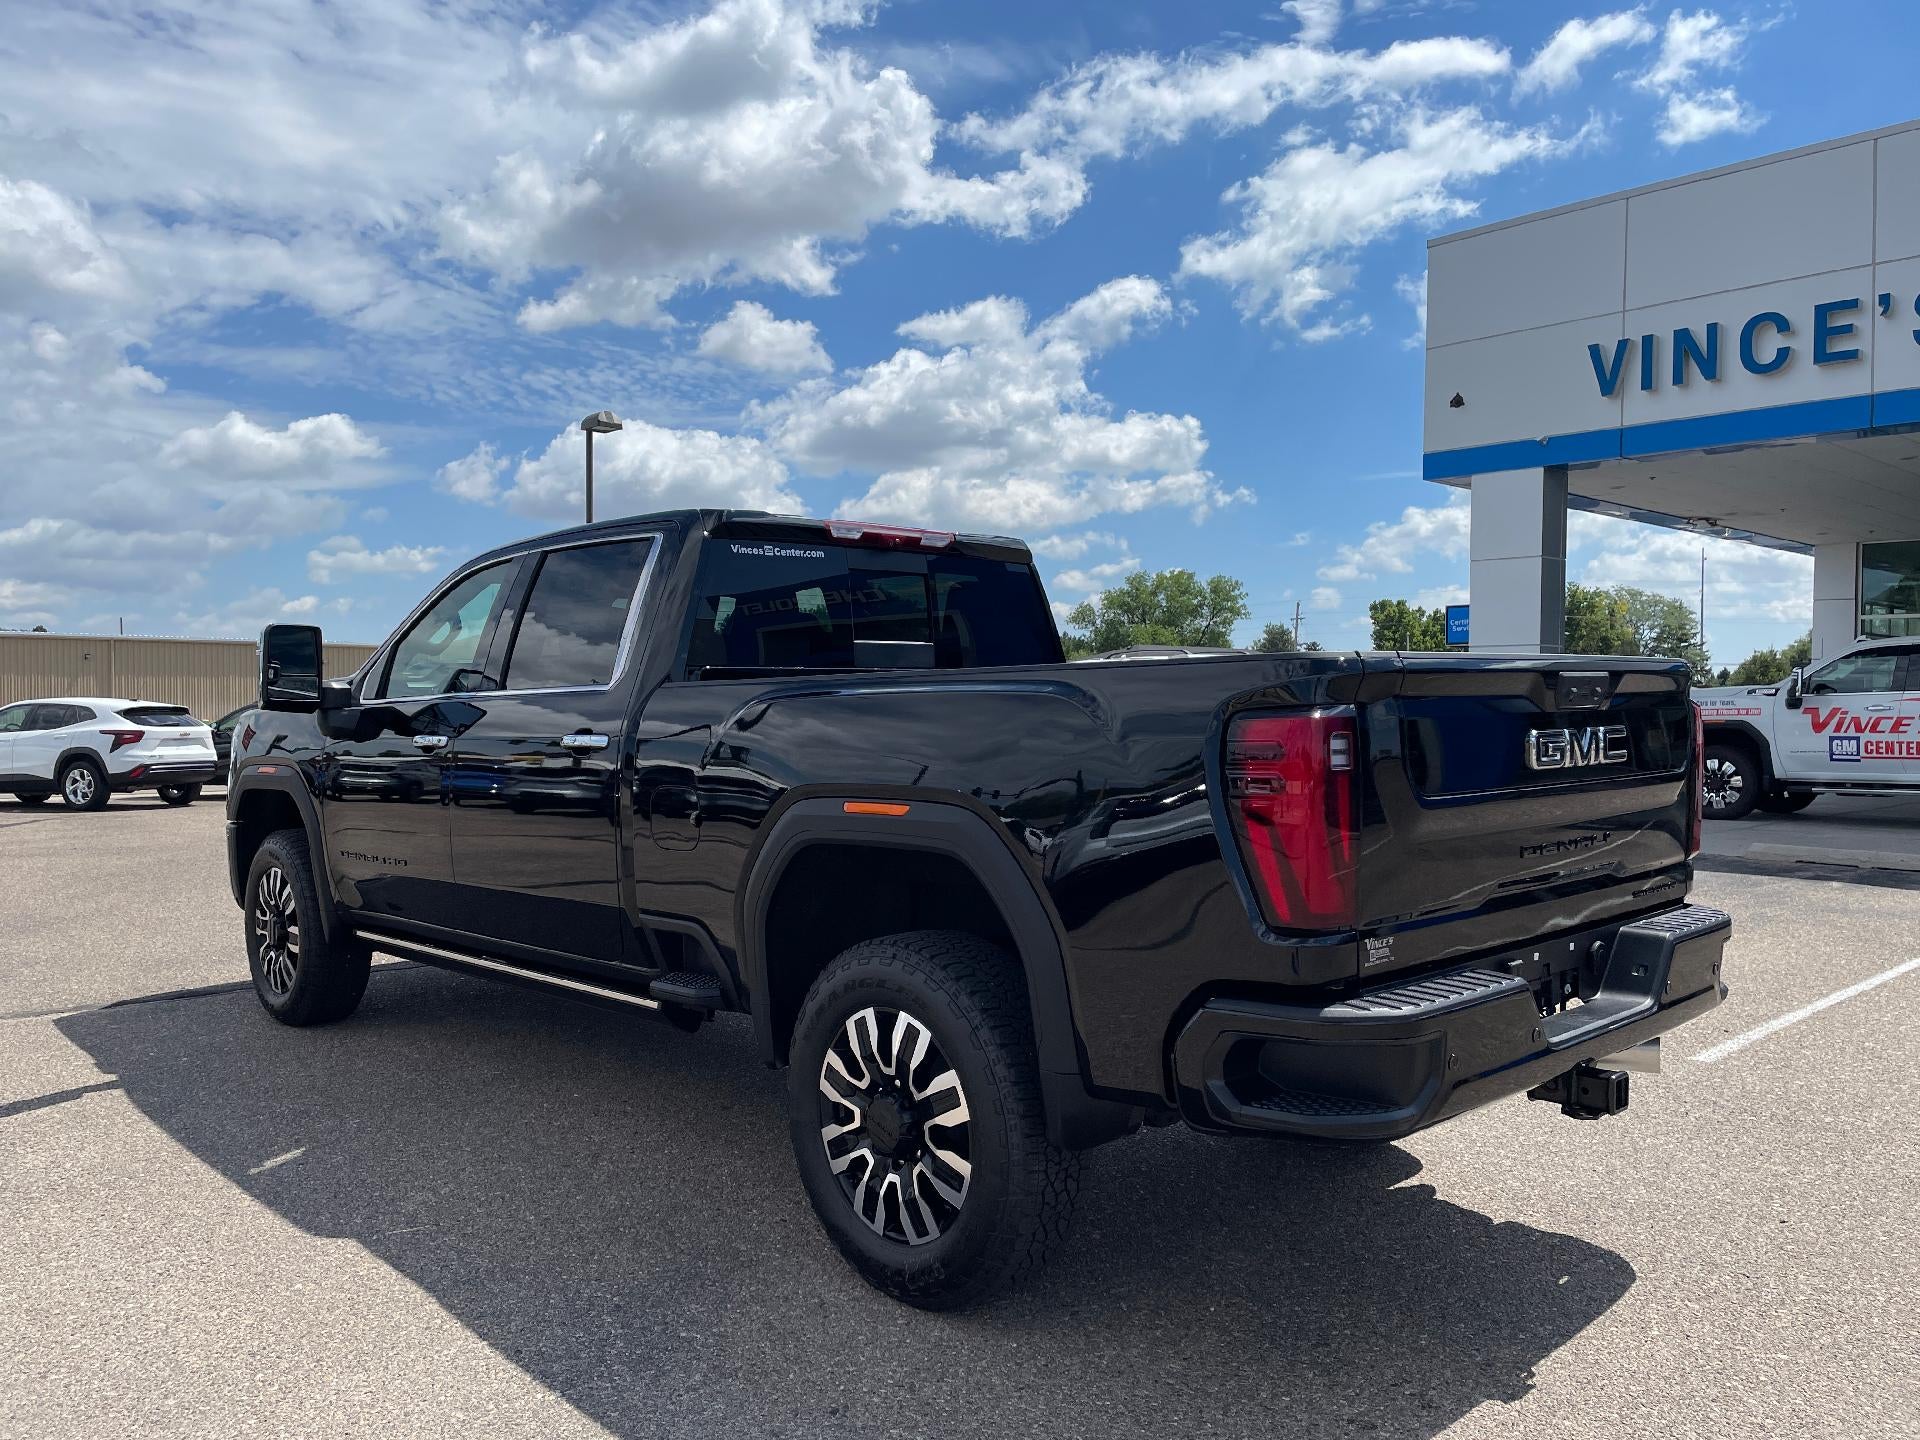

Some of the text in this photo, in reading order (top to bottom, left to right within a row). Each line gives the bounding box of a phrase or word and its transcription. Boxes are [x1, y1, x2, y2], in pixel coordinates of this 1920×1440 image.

[1587, 292, 1920, 398] VINCE'
[1525, 725, 1627, 770] GMC
[1832, 739, 1858, 755] GM
